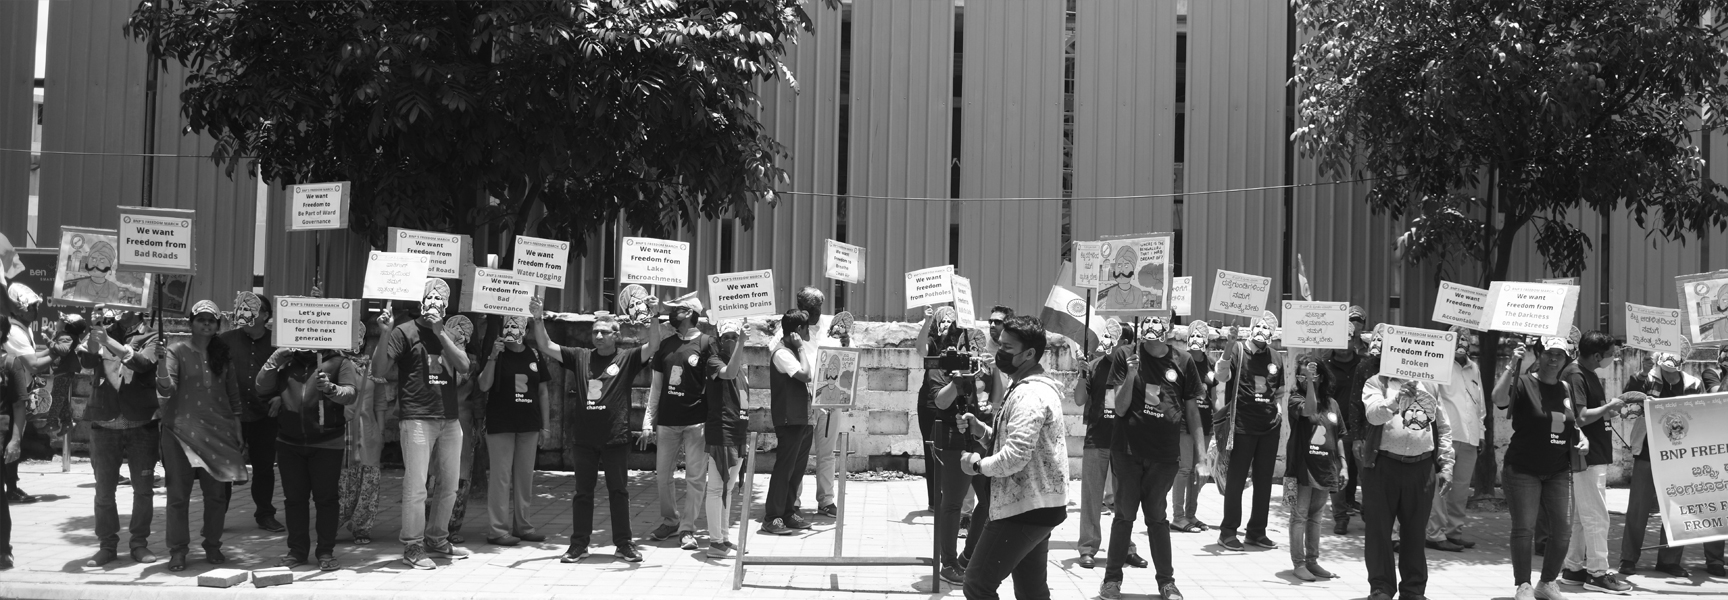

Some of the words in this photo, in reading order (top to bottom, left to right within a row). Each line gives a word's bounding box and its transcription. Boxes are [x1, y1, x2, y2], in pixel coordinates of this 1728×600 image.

[126, 238, 163, 247] Freedom
[165, 240, 186, 248] from
[152, 251, 178, 259] Roads
[518, 259, 544, 268] Freedom
[536, 271, 562, 282] Logging
[628, 274, 682, 283] Encroachments
[482, 286, 511, 294] Freedom
[484, 304, 523, 312] Governance
[1446, 299, 1471, 308] Freedom
[1518, 312, 1549, 320] Darkness
[1642, 326, 1659, 334] ನಮಗೆ
[1414, 339, 1434, 347] want
[1390, 346, 1422, 356] Freedom
[1424, 350, 1444, 358] from
[1401, 358, 1429, 367] Broken
[1396, 368, 1434, 379] Footpaths
[1143, 409, 1164, 418] change
[1660, 448, 1687, 461] BNP
[1679, 502, 1717, 515] LET'S
[1684, 518, 1723, 530] FROM
